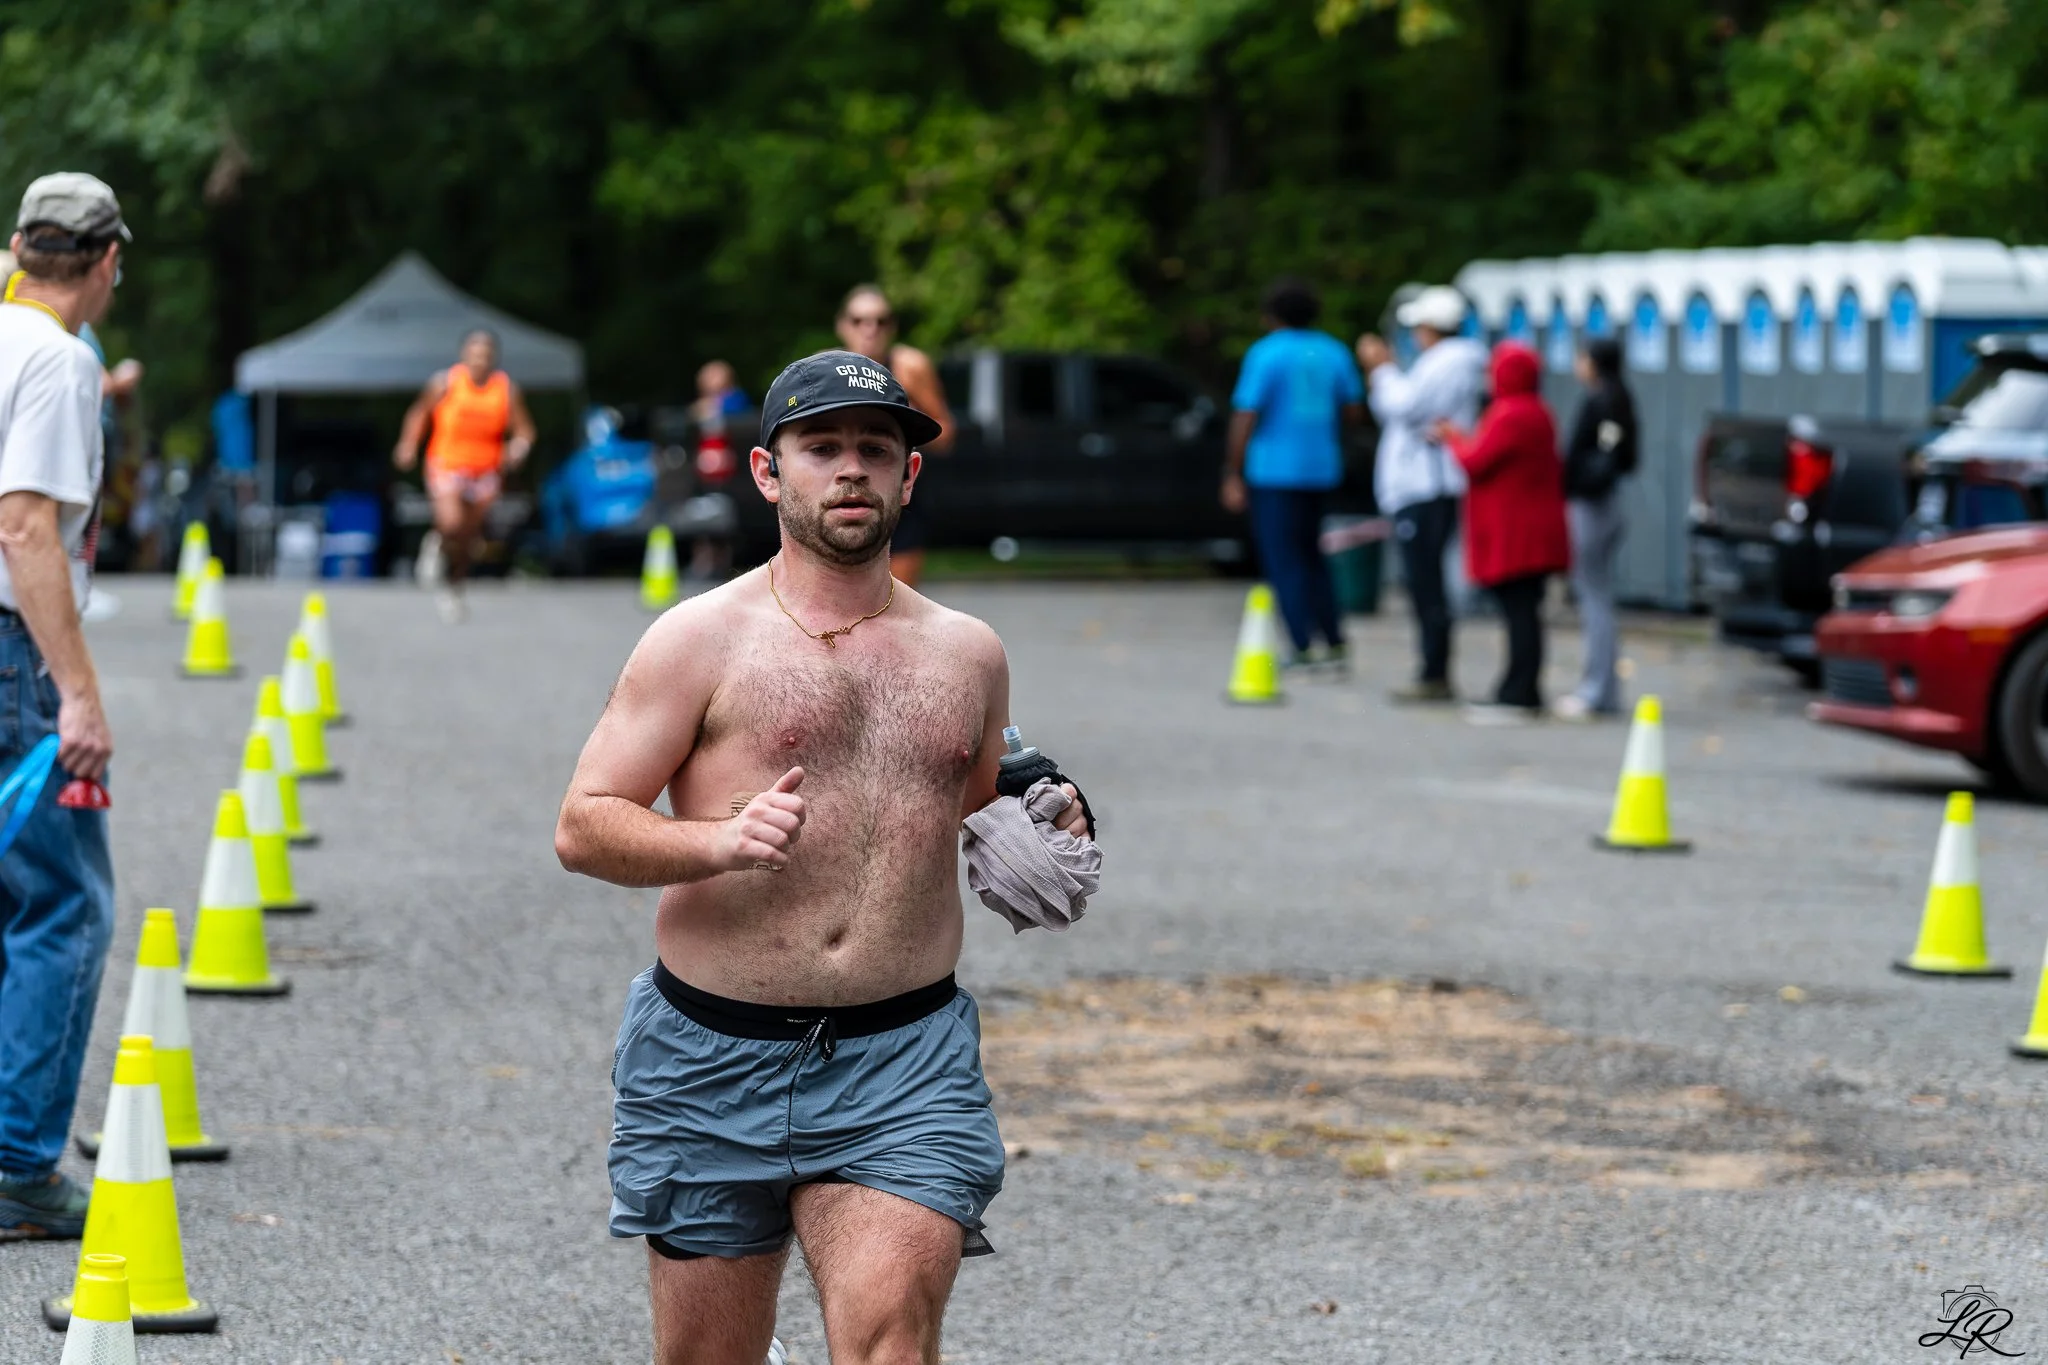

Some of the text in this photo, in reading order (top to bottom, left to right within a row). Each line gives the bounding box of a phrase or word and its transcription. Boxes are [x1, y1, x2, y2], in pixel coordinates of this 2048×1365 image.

[836, 365, 888, 387] GO ONE
[848, 376, 885, 394] MORE
